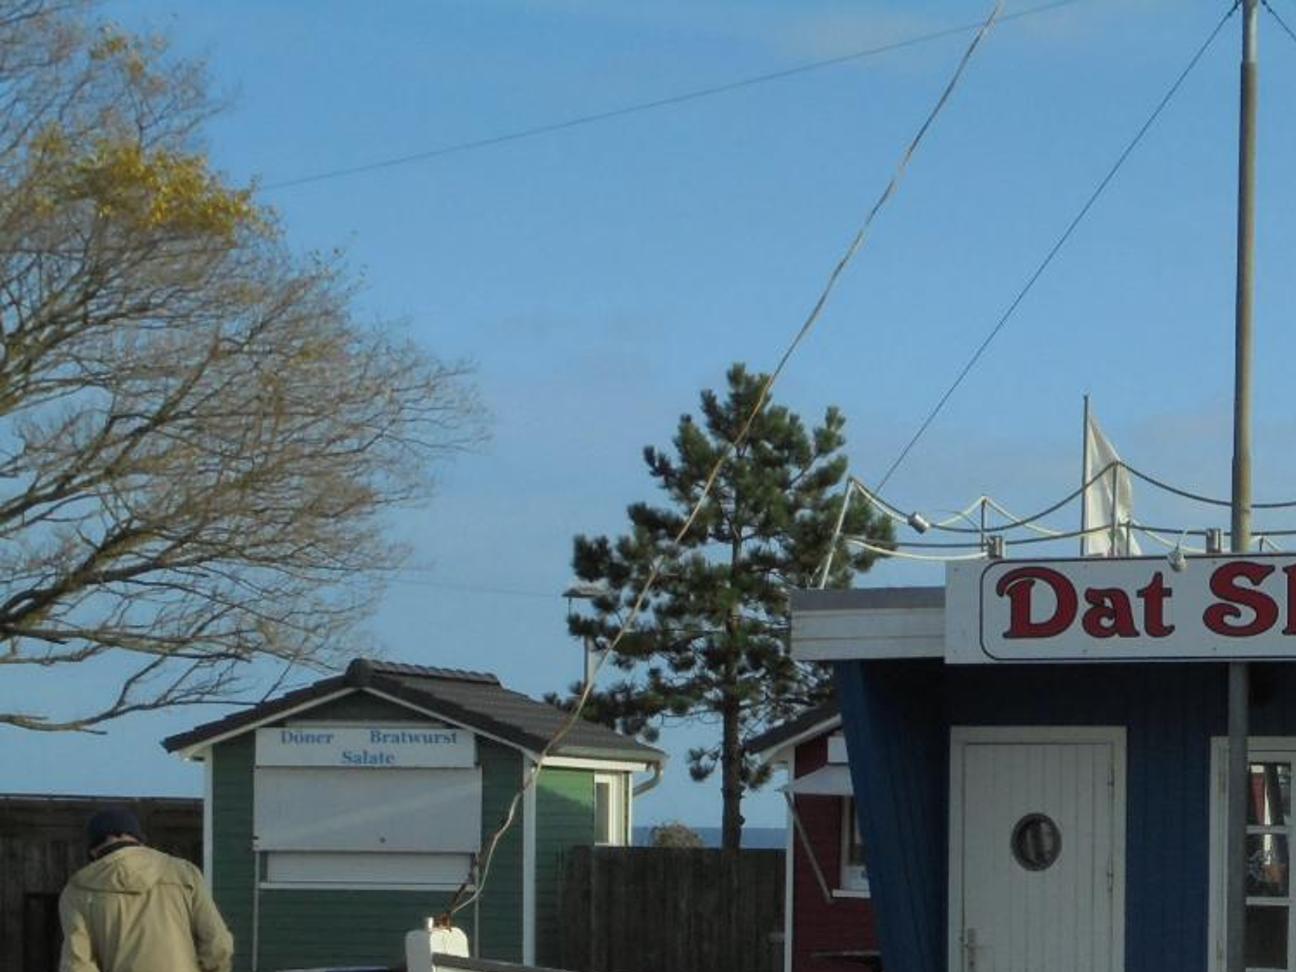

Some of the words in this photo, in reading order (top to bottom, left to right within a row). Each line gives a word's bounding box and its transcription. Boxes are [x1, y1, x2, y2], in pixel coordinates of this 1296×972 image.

[996, 565, 1175, 639] Dat
[280, 730, 334, 745] Döner
[369, 730, 458, 745] Bratwurst
[341, 750, 396, 765] Salate
